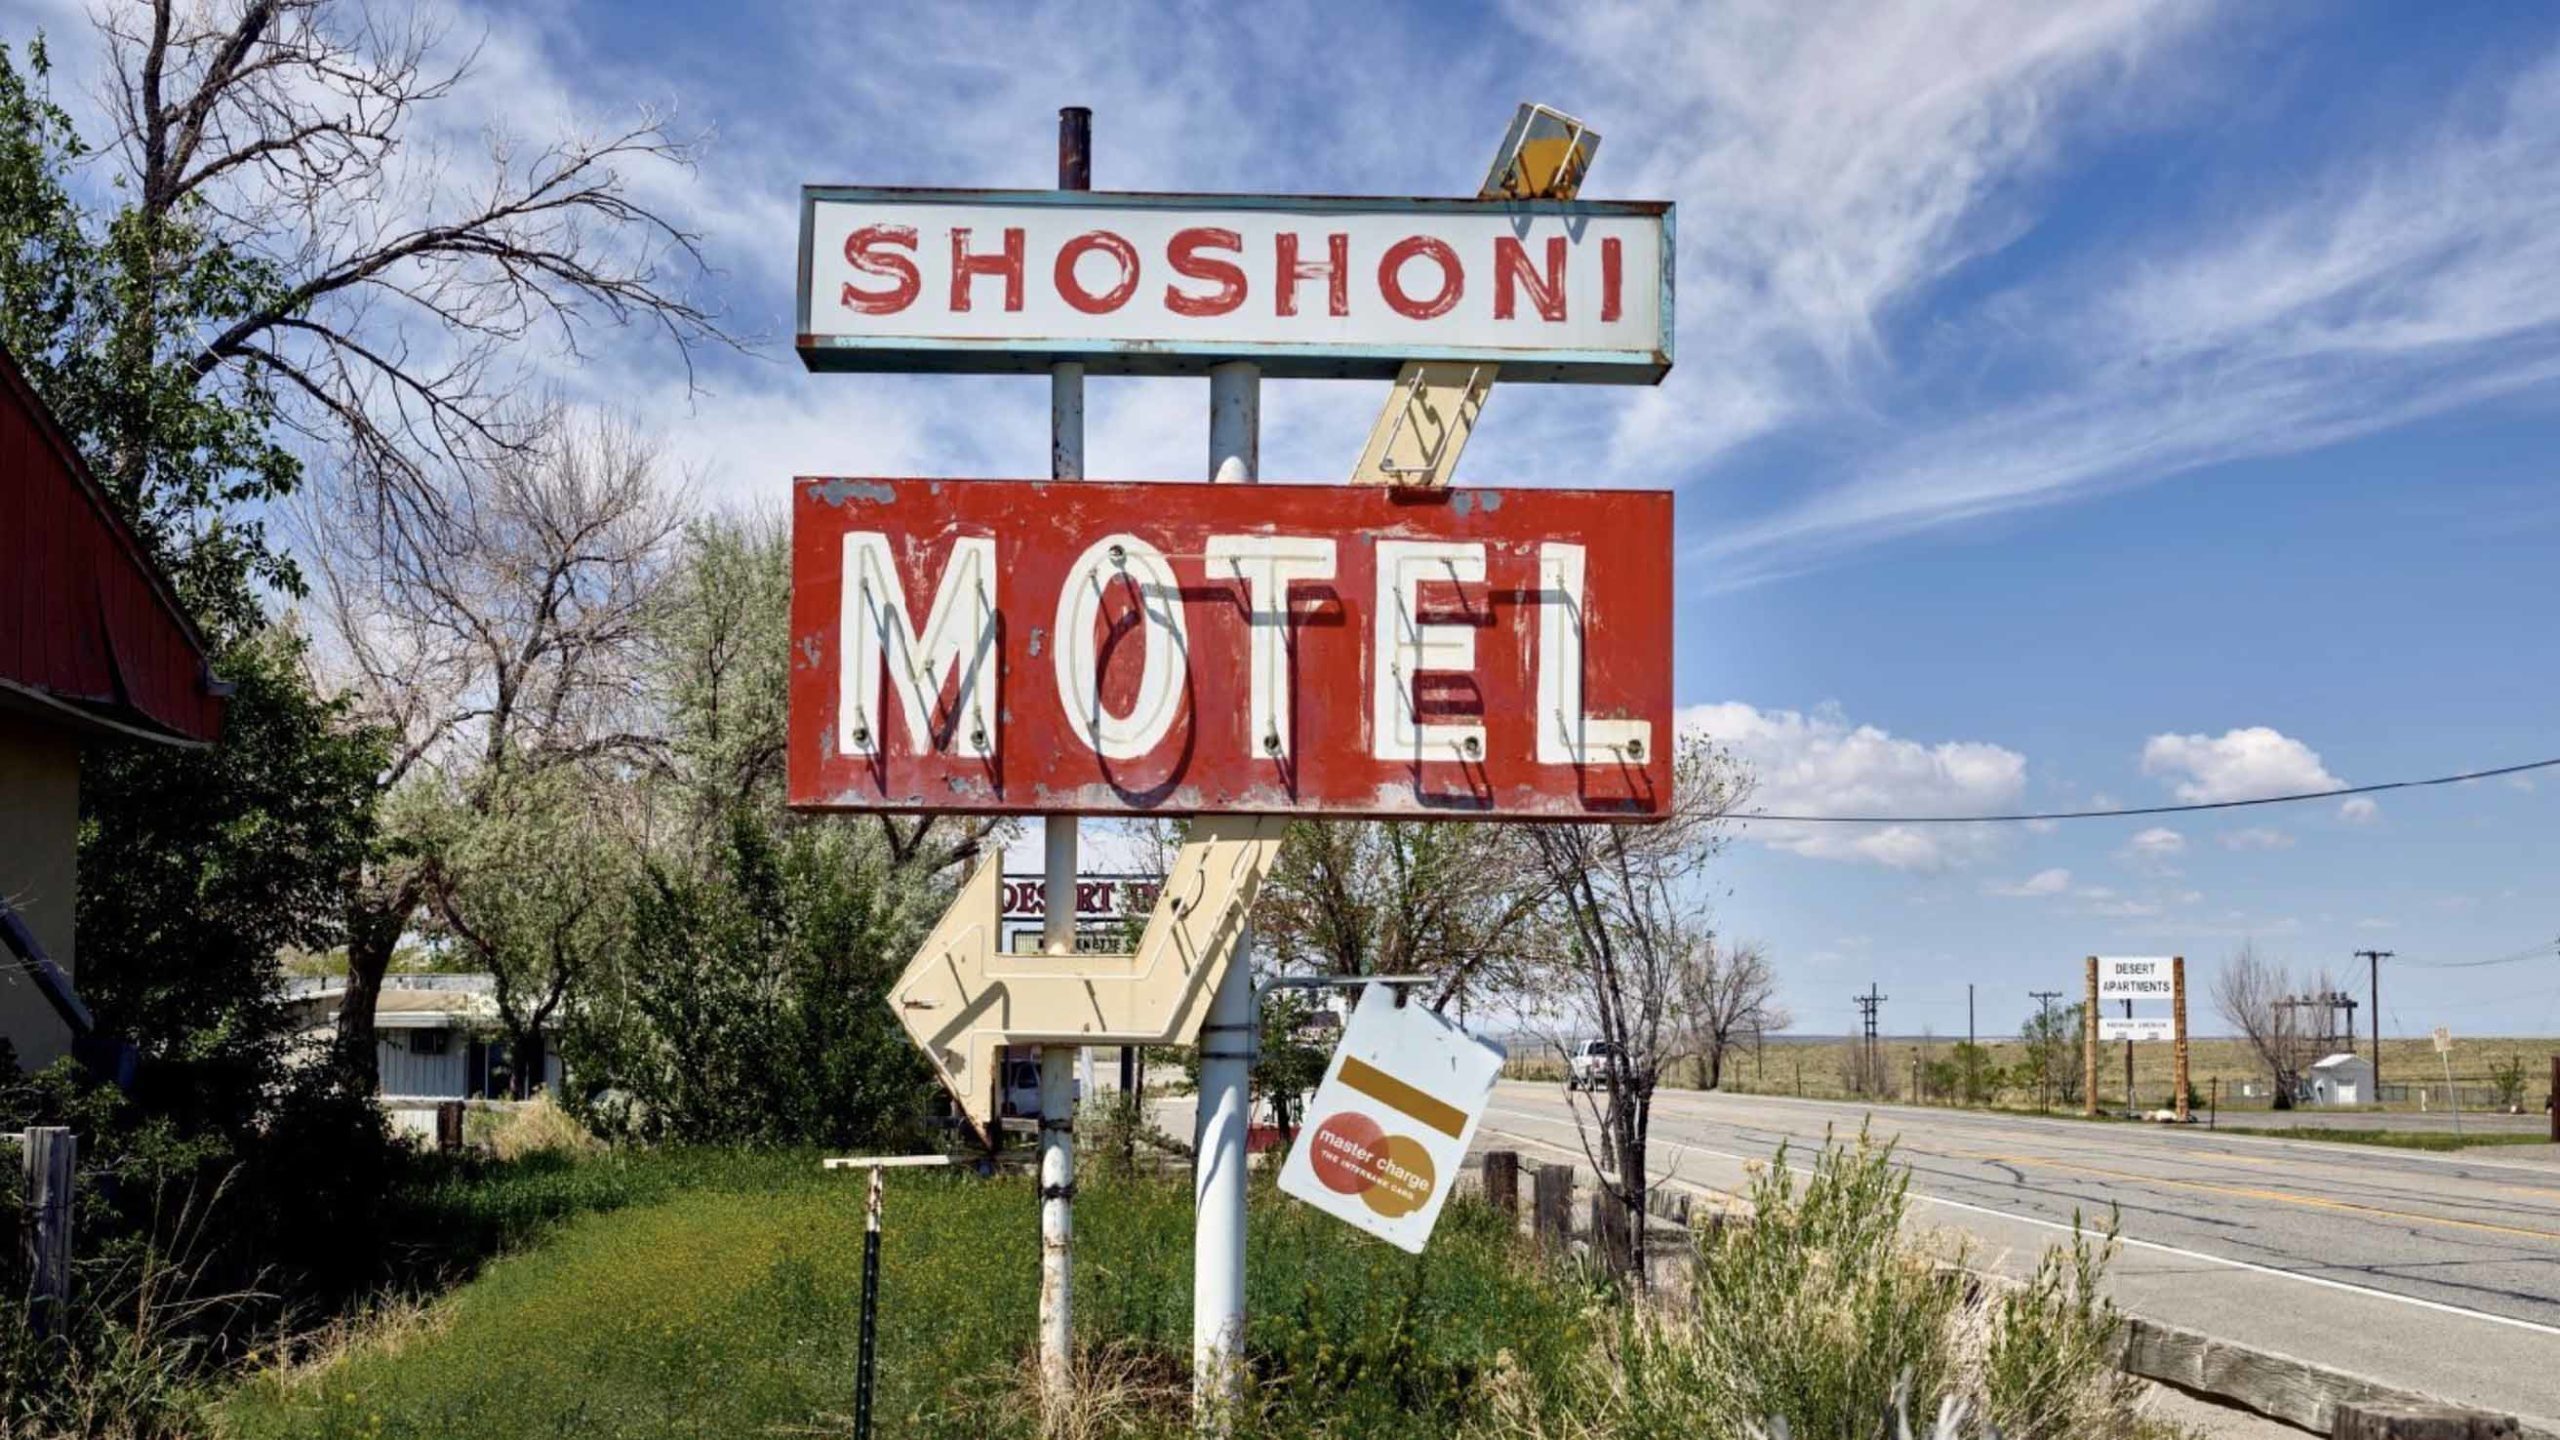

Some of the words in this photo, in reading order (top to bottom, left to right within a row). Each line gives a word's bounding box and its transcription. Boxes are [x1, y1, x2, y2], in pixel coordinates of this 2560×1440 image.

[841, 221, 1622, 323] SHOSHONI
[838, 530, 1652, 765] MOTEL
[1002, 882, 1116, 914] DESRT
[2115, 962, 2155, 976] DESERT
[2103, 980, 2171, 992] APARTMENTS
[1319, 1129, 1375, 1163] master
[1376, 1158, 1430, 1190] charge
[1321, 1149, 1340, 1164] THE
